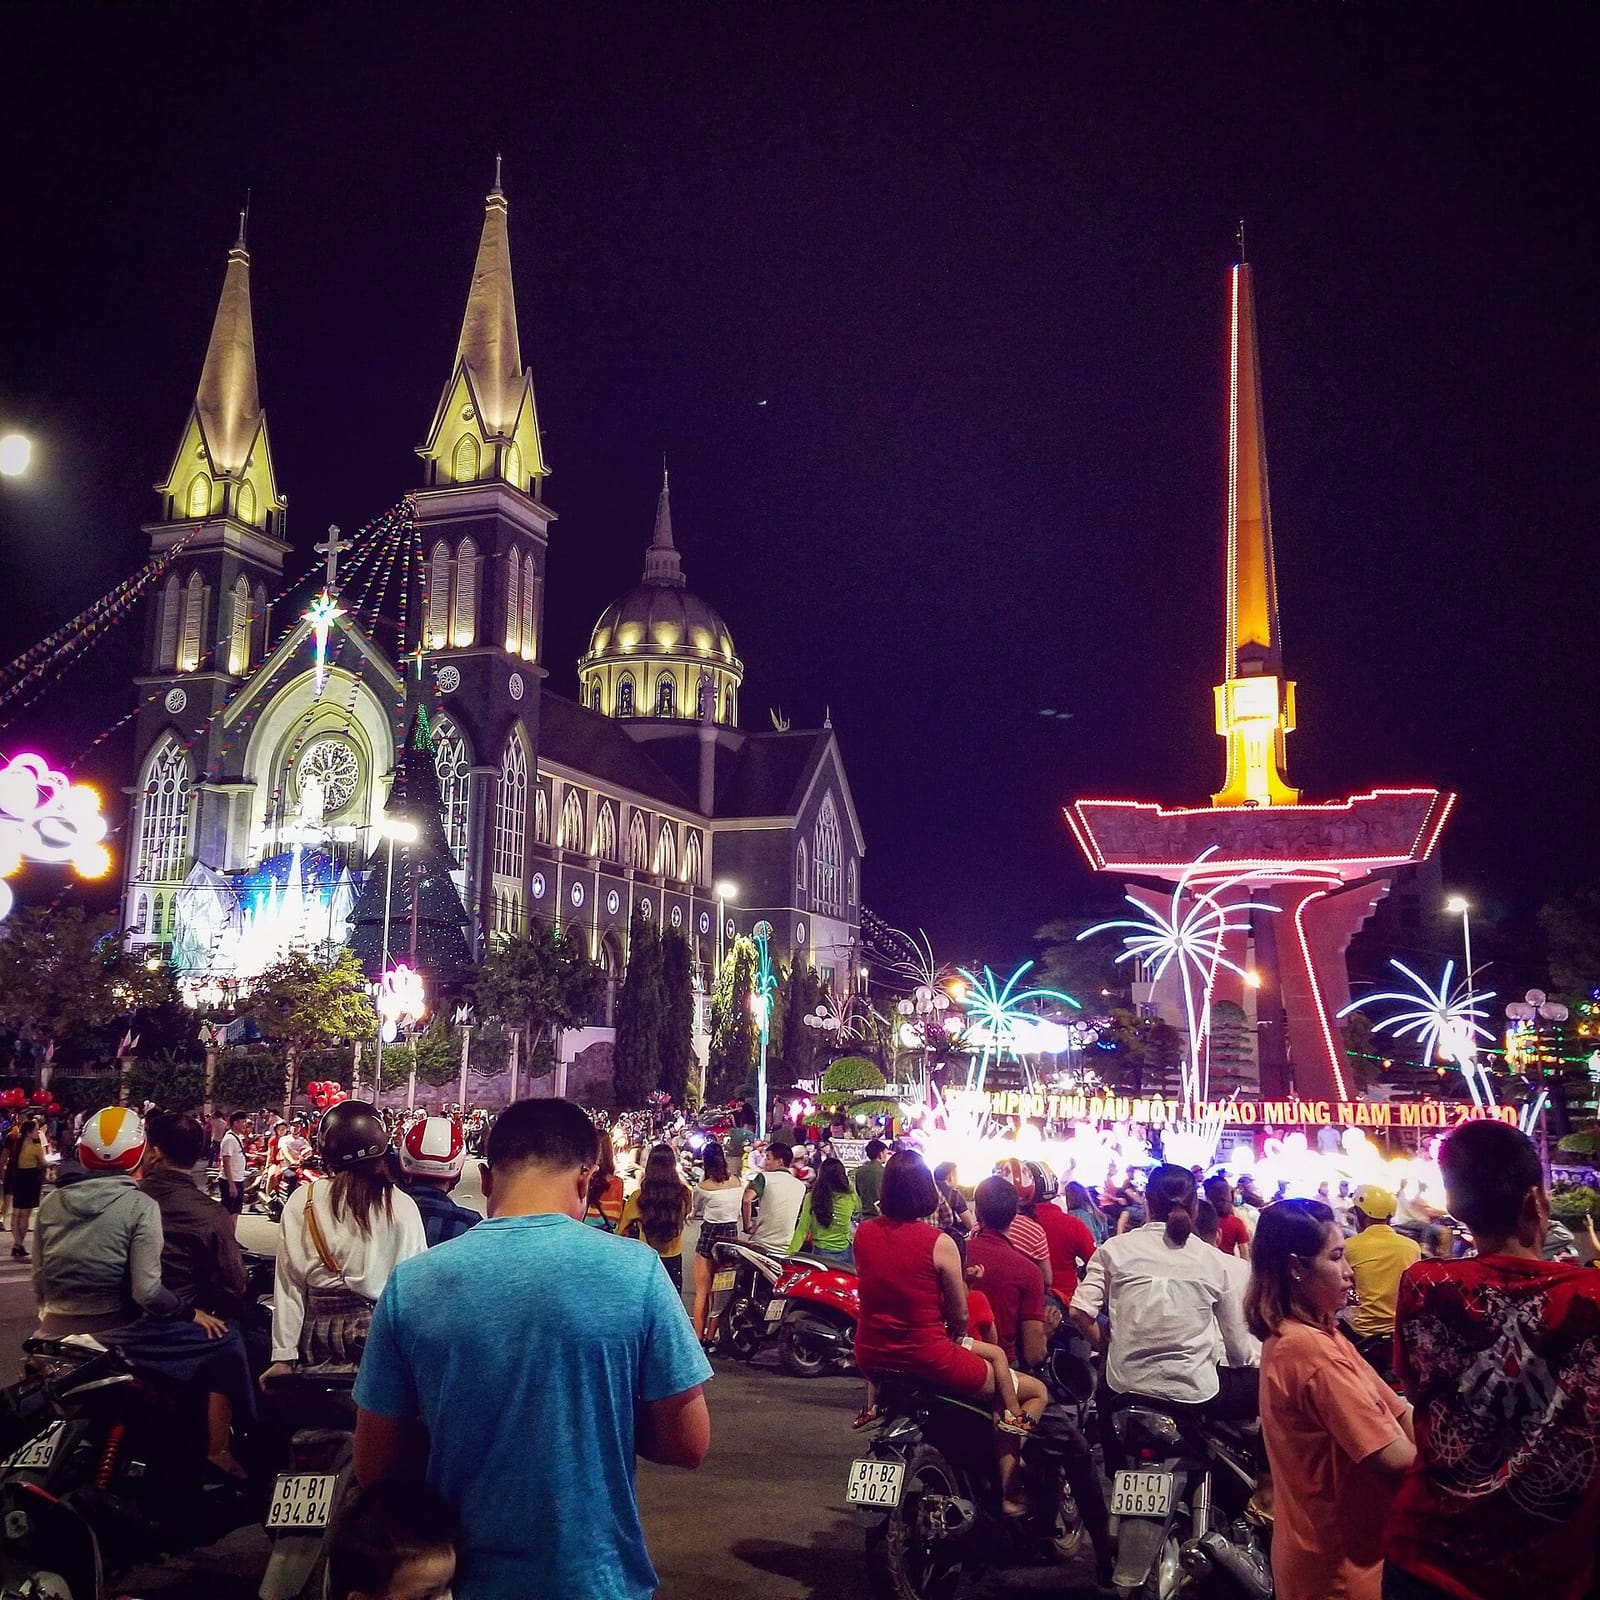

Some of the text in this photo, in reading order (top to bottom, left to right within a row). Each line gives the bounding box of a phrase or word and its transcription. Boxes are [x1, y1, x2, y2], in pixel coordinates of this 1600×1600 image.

[1264, 1096, 1331, 1125] MỪNG
[1338, 1096, 1391, 1126] NĂM
[1400, 1094, 1447, 1127] MỚI
[283, 1478, 326, 1500] 61-B1
[850, 1482, 897, 1503] 510.21
[1123, 1474, 1162, 1493] 61-C1
[271, 1502, 326, 1524] 934.84
[1116, 1493, 1166, 1513] 366.92
